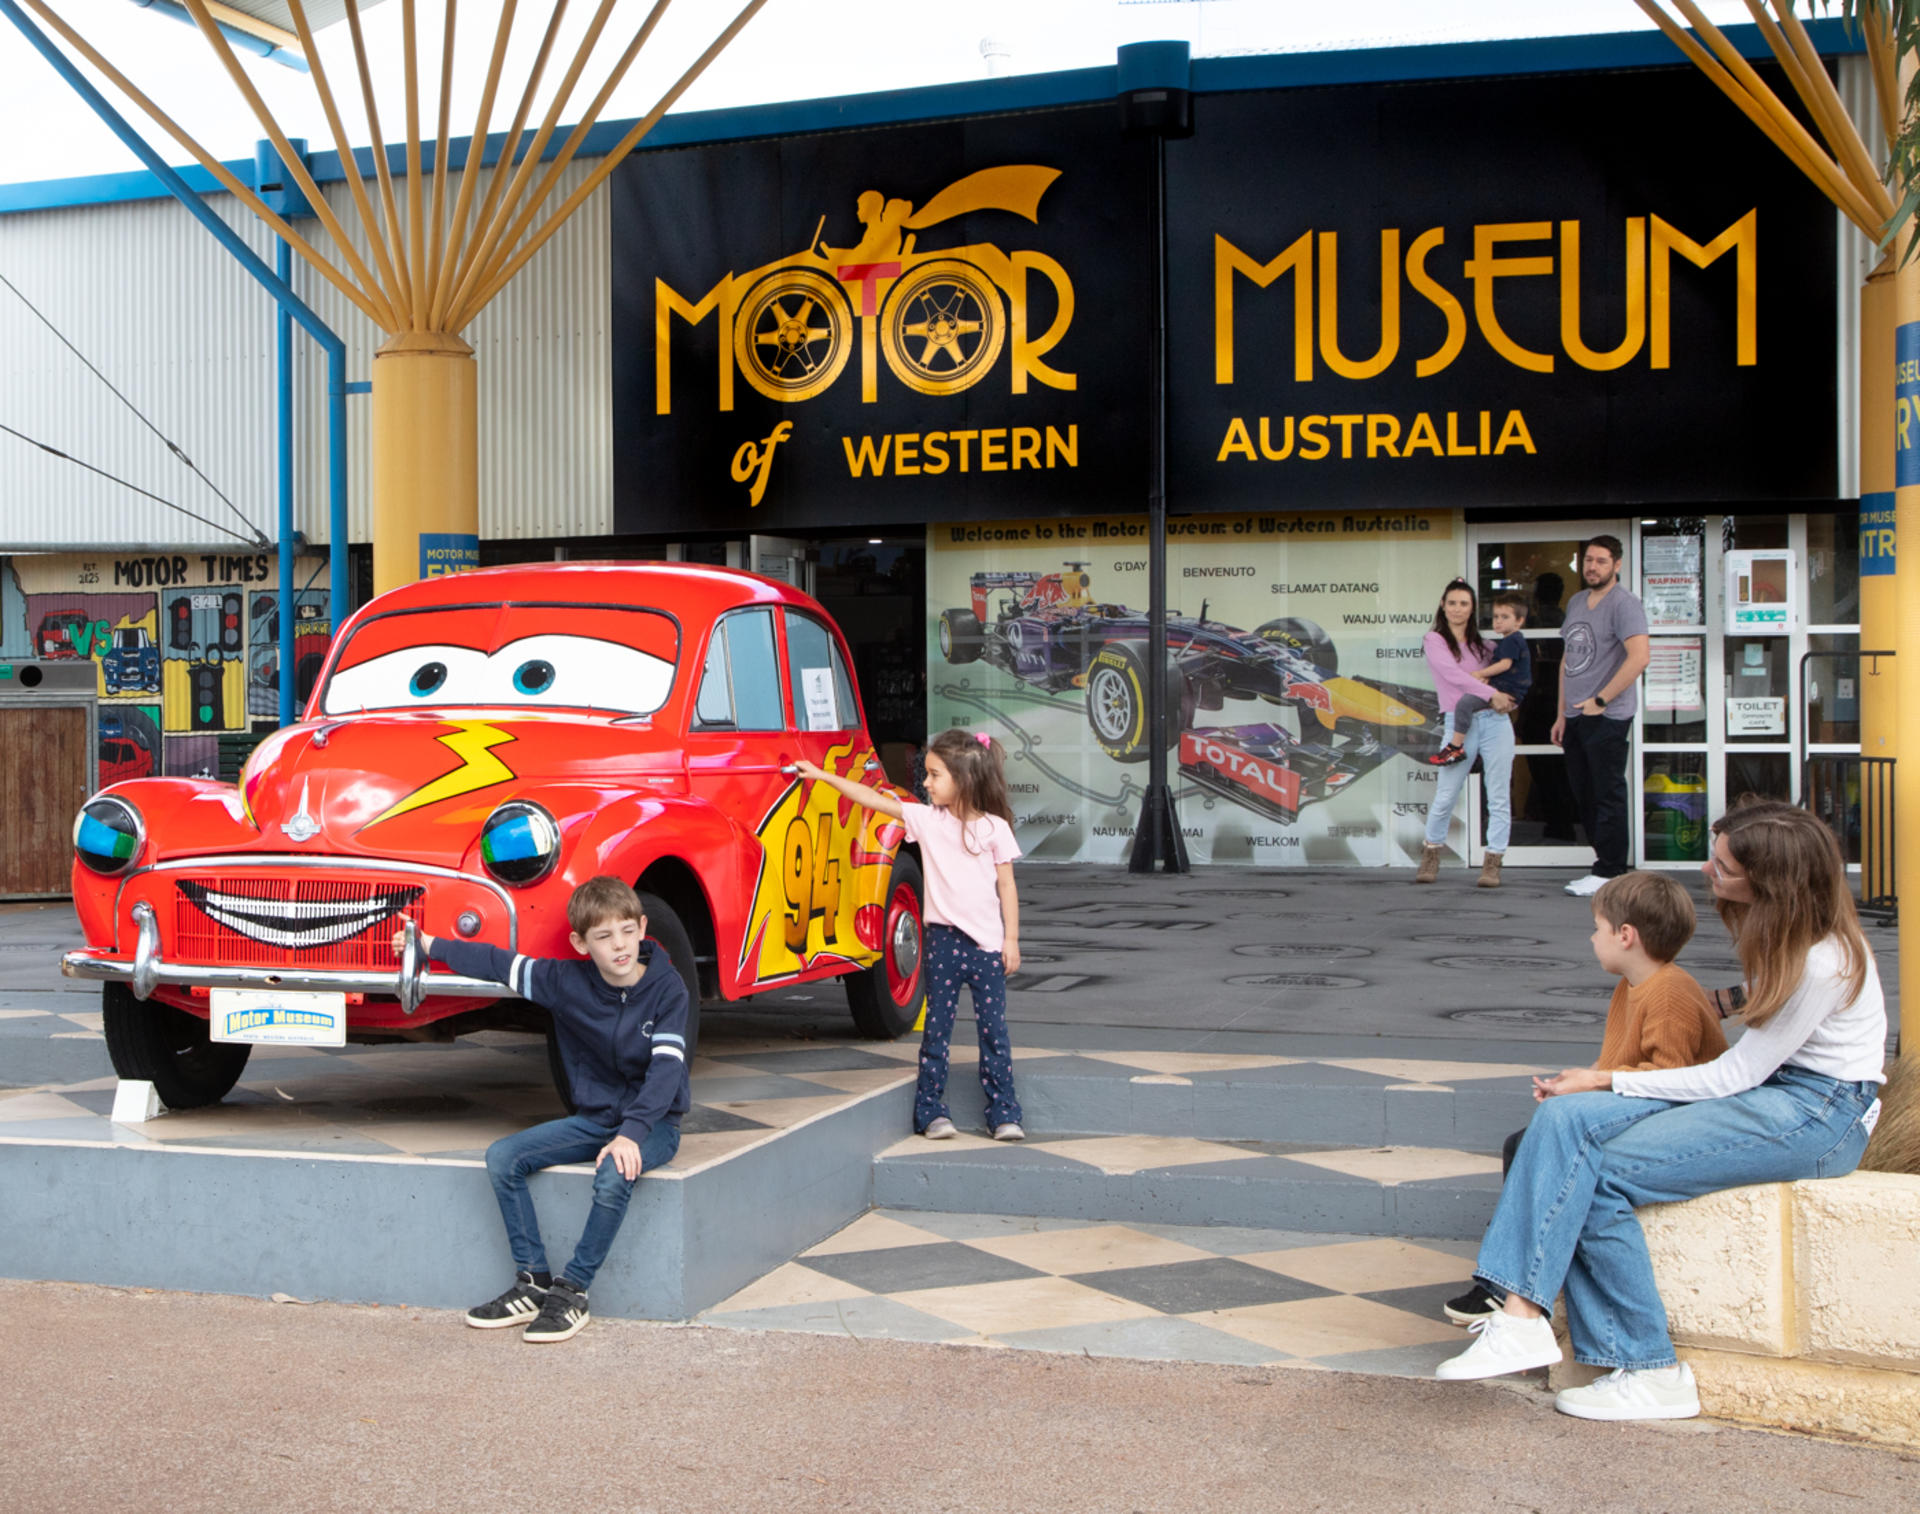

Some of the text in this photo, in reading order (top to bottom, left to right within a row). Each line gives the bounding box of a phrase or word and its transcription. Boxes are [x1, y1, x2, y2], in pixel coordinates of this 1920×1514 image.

[655, 207, 1758, 416] MOTOR MUSEUM
[730, 410, 1538, 508] of WESTERN AUSTRALIA
[951, 515, 1431, 543] Welcome to the Motor useum of Western Australia
[426, 548, 463, 560] MOTOR
[114, 554, 269, 588] MOTOR TIMES
[1183, 566, 1256, 578] BENVENUTO
[1271, 582, 1379, 594] SELAMAT DATANG
[1343, 613, 1432, 625] WANJU WANJU
[68, 619, 113, 656] VS
[1736, 702, 1778, 712] TOILET
[1187, 735, 1288, 794] TOTAL
[1407, 769, 1439, 782] FÁILT
[1093, 827, 1116, 837] NAU
[1119, 828, 1135, 837] MA
[1246, 836, 1300, 847] WELKOM
[783, 813, 841, 954] 94
[229, 1010, 332, 1030] Motor Museum
